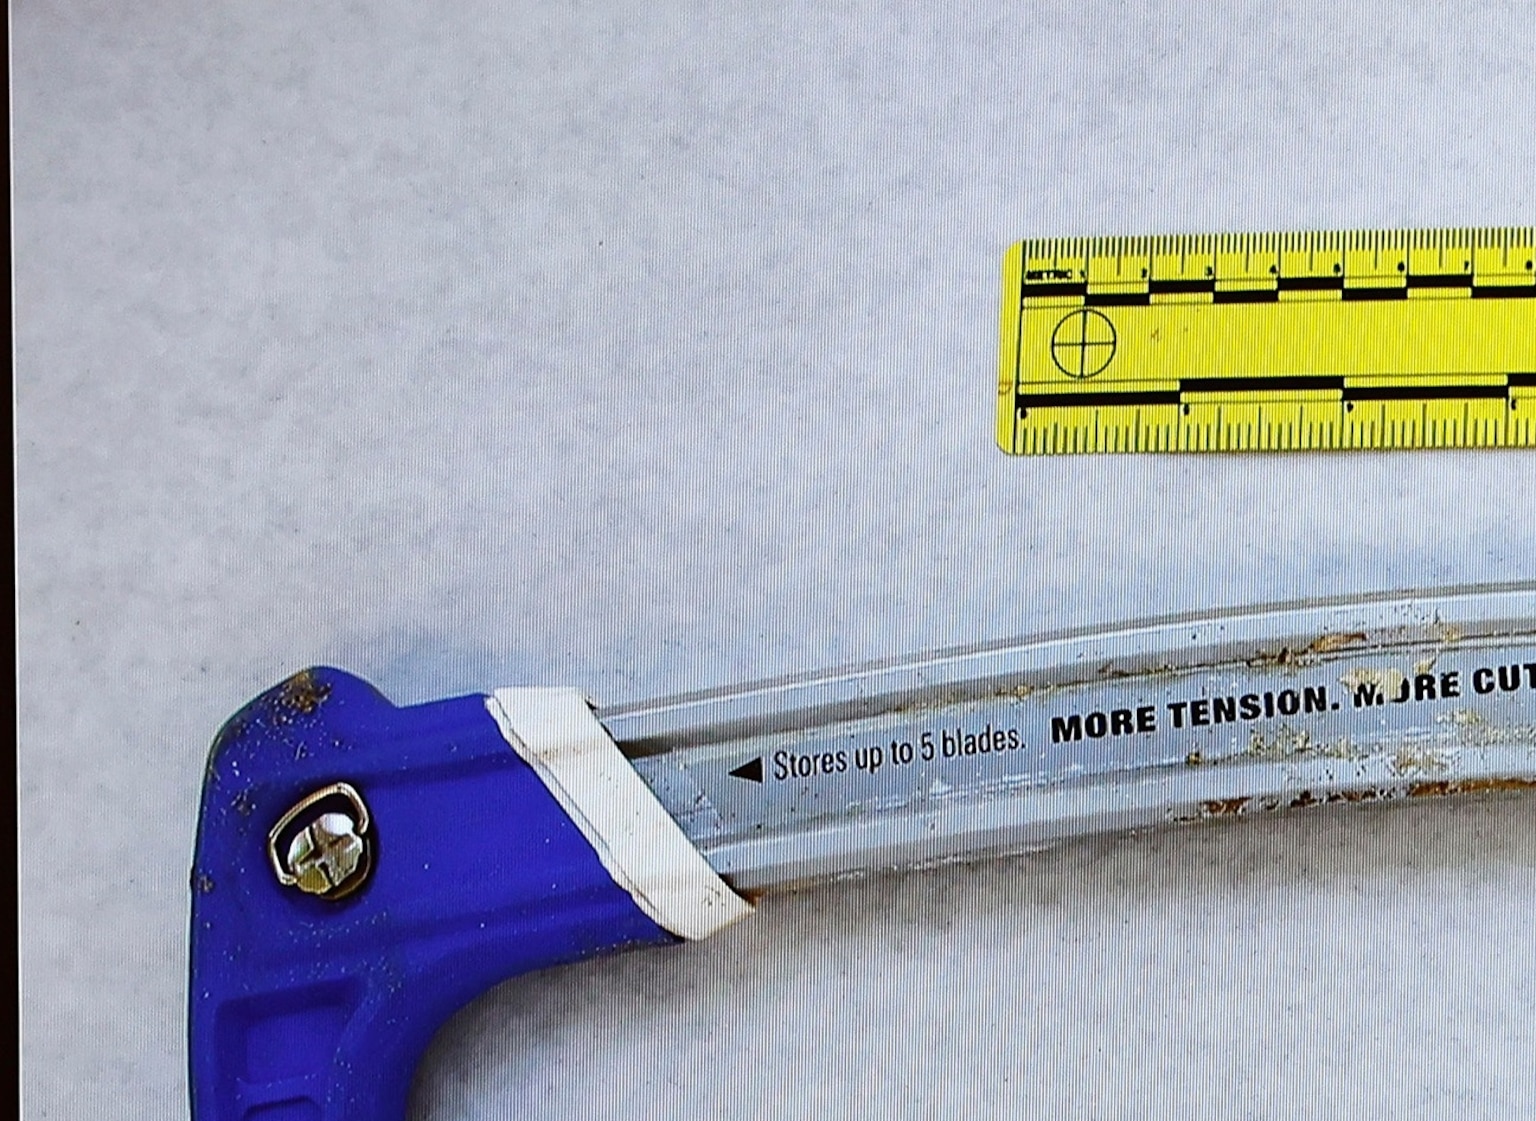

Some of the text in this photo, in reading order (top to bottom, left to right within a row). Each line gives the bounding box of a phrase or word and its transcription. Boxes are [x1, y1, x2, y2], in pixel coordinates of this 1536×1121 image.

[1050, 705, 1157, 744] MORE
[1167, 686, 1340, 729] TENSION.
[772, 724, 1026, 782] Stores up to 5 blades.
